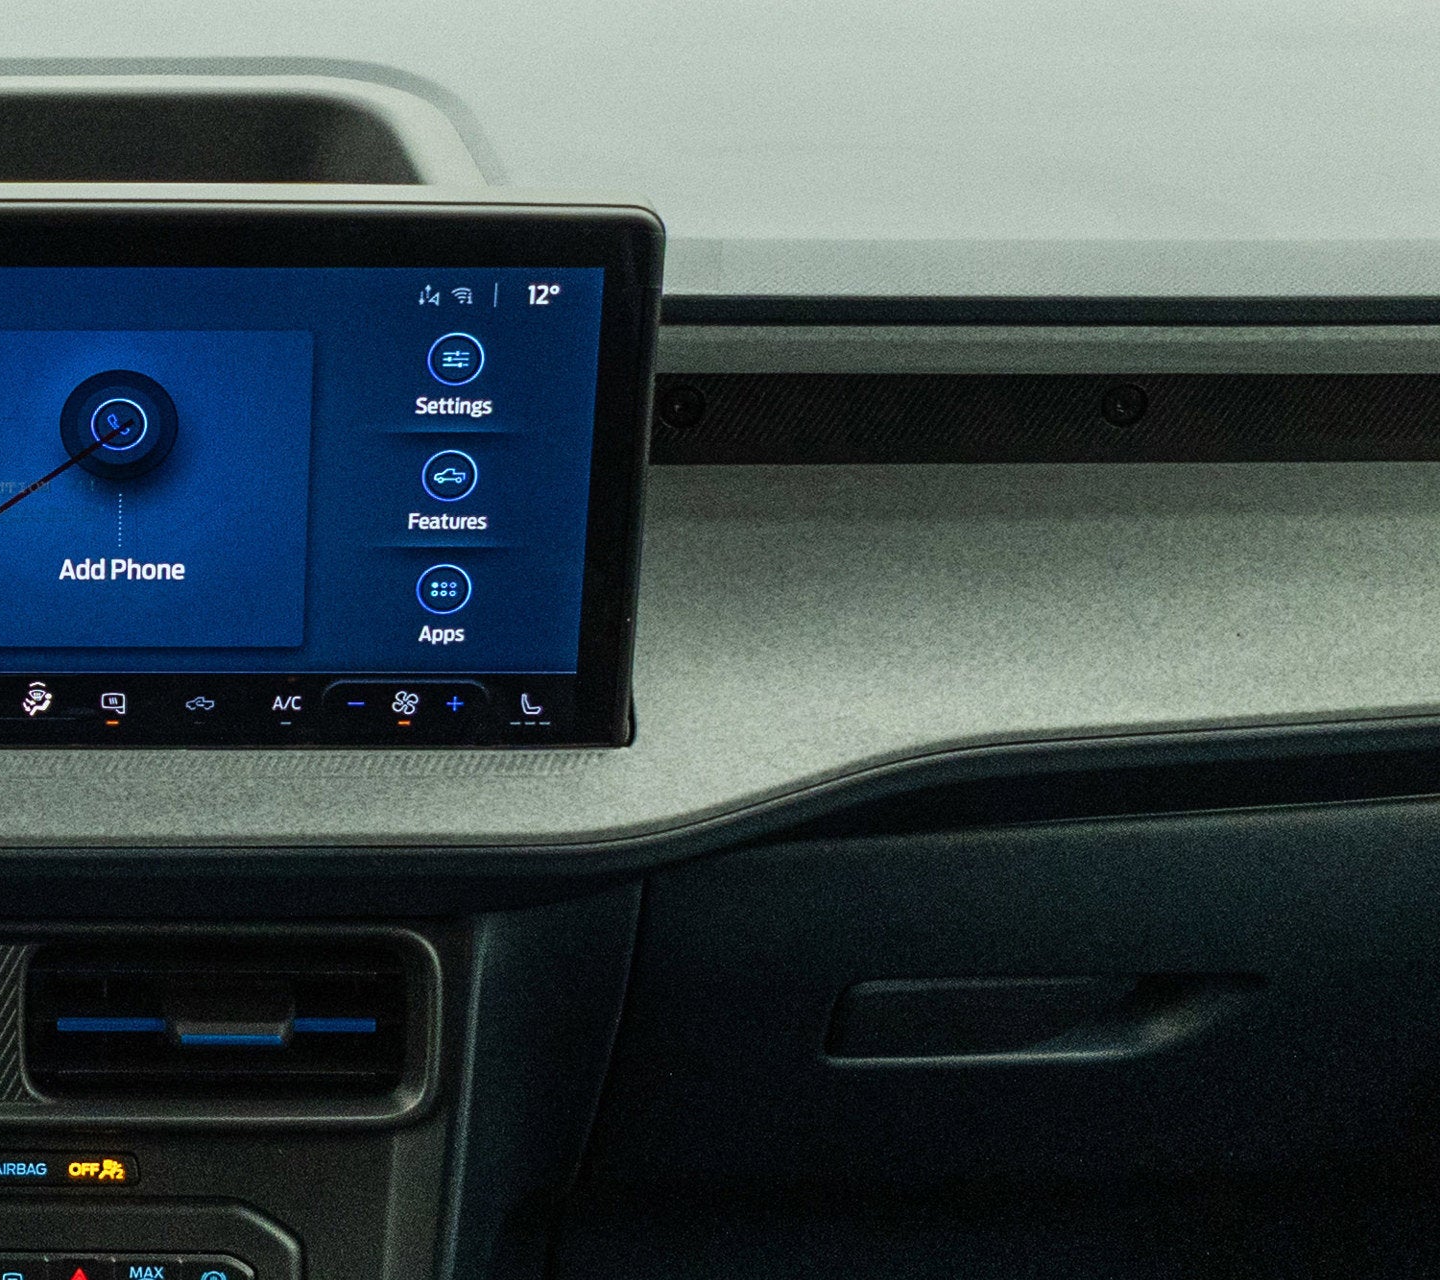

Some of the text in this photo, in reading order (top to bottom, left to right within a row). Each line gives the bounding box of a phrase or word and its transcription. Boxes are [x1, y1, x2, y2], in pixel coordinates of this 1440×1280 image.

[528, 284, 560, 305] 12°
[415, 397, 493, 418] Settings
[408, 512, 488, 530] Features
[59, 558, 186, 581] Add Phone
[418, 624, 466, 646] Apps
[272, 695, 302, 711] A/C
[69, 1162, 99, 1176] OFF
[130, 1267, 164, 1279] MAX
